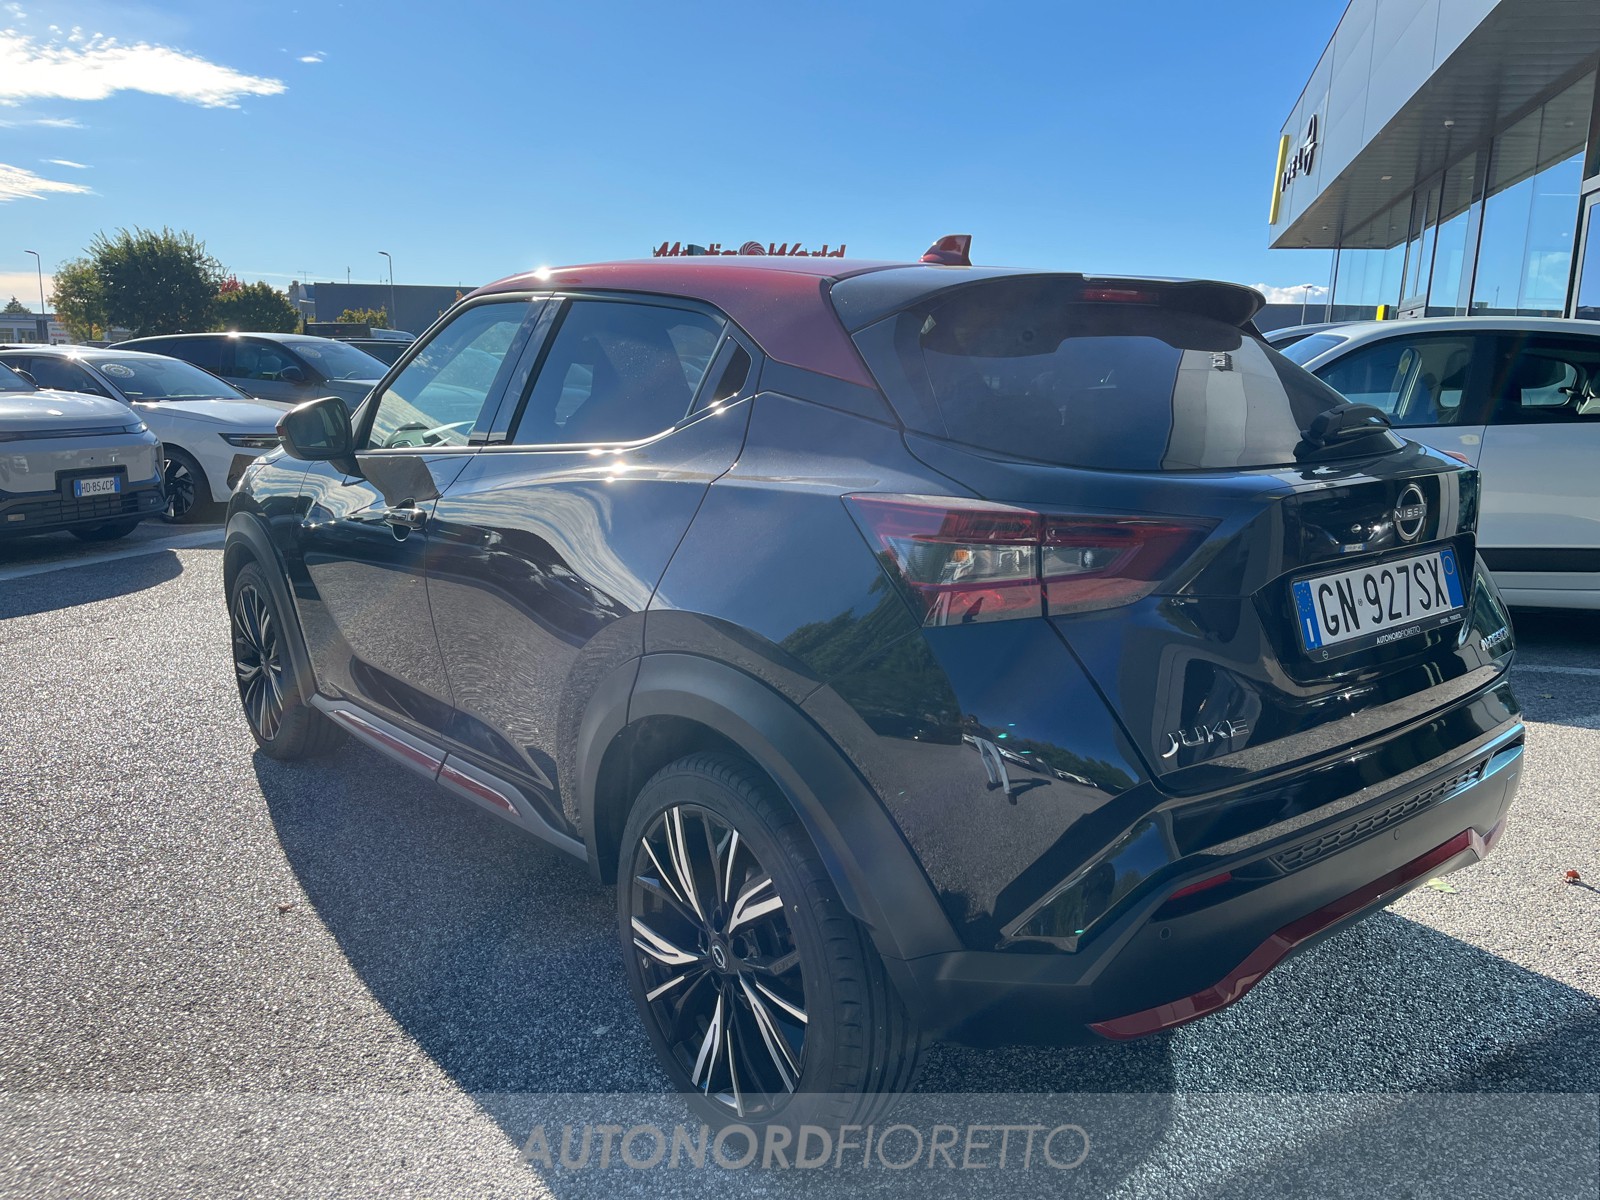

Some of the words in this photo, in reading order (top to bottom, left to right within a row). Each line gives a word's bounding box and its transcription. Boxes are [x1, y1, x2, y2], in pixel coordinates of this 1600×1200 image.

[1318, 578, 1360, 636] GN
[1363, 558, 1447, 625] 927SX
[1162, 719, 1249, 758] JUKE
